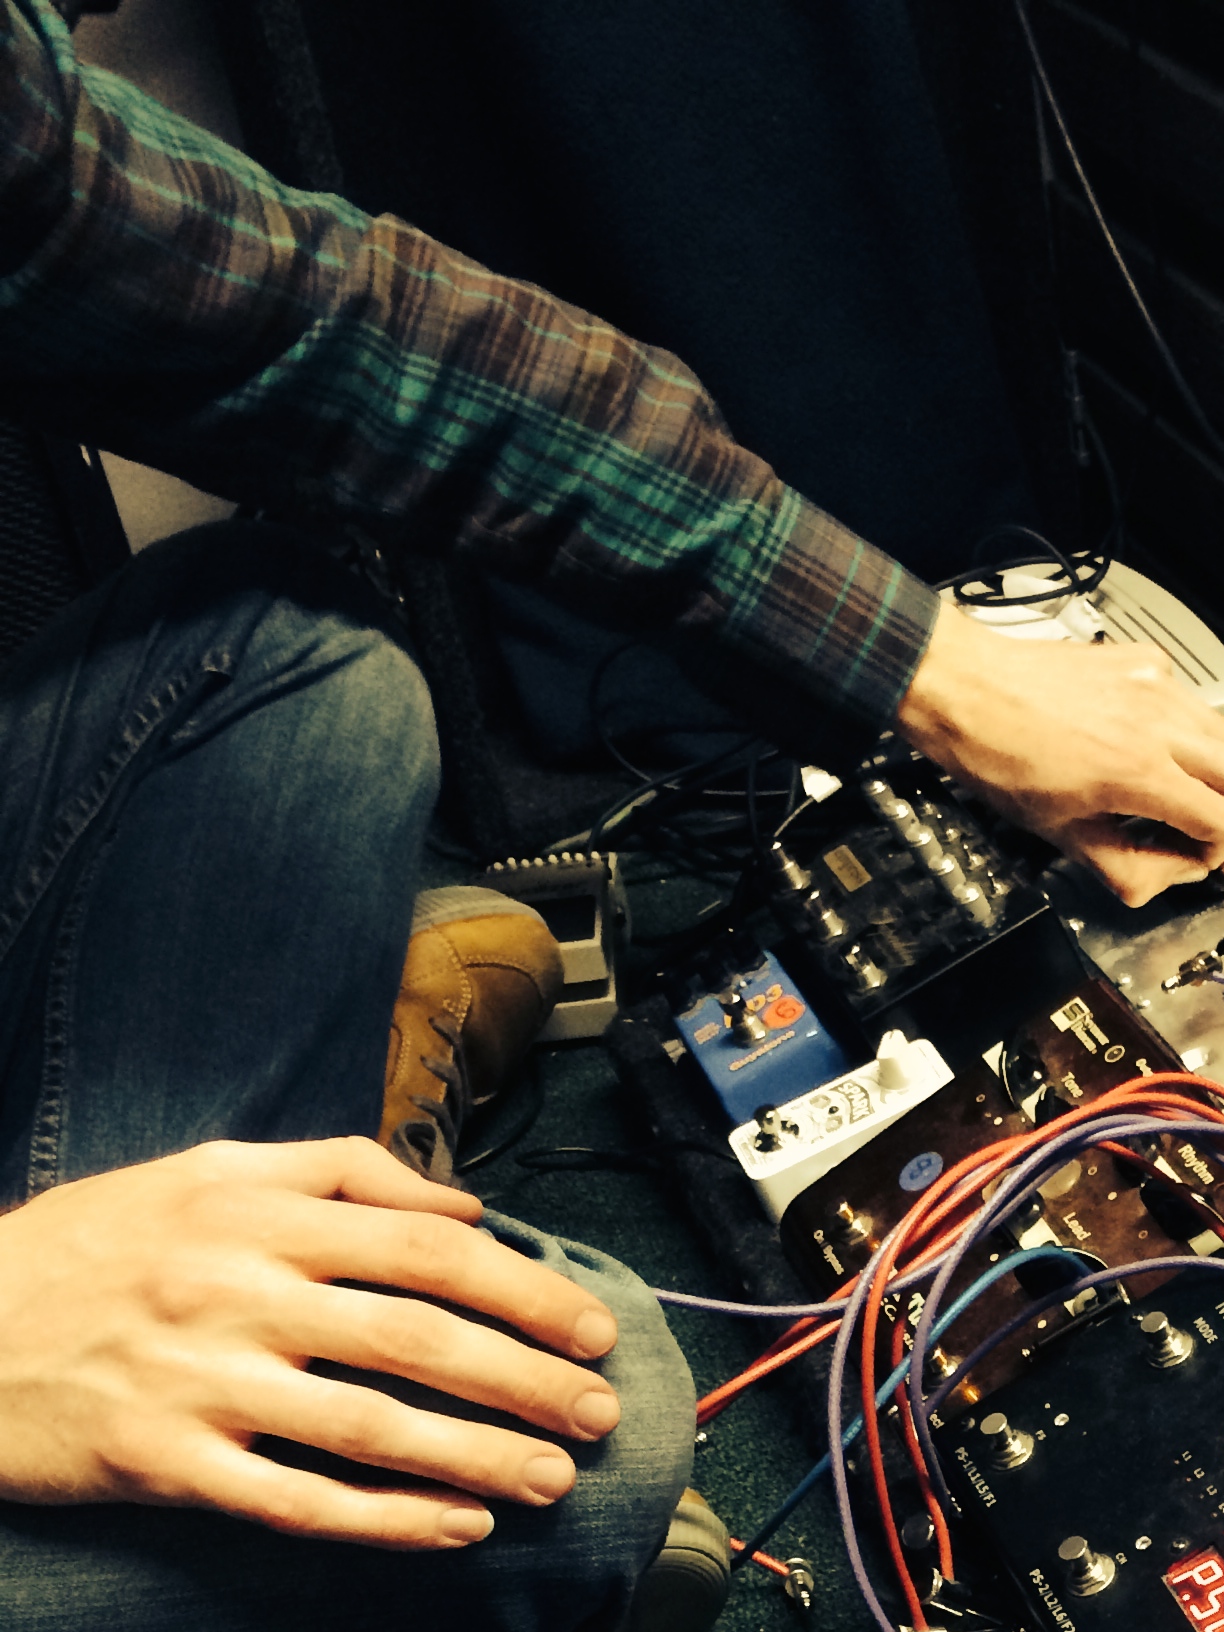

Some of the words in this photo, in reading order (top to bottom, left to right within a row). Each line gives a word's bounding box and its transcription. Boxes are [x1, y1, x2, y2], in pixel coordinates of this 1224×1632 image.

[1061, 1071, 1084, 1098] Tone
[836, 1082, 872, 1123] SPARK
[1178, 1143, 1215, 1185] Rhythm
[1062, 1211, 1092, 1241] Lead
[1193, 1316, 1219, 1345] MODE
[1180, 1450, 1193, 1462] L1
[954, 1446, 998, 1509] PS-1/L1/L5/F1
[1206, 1484, 1219, 1497] L3
